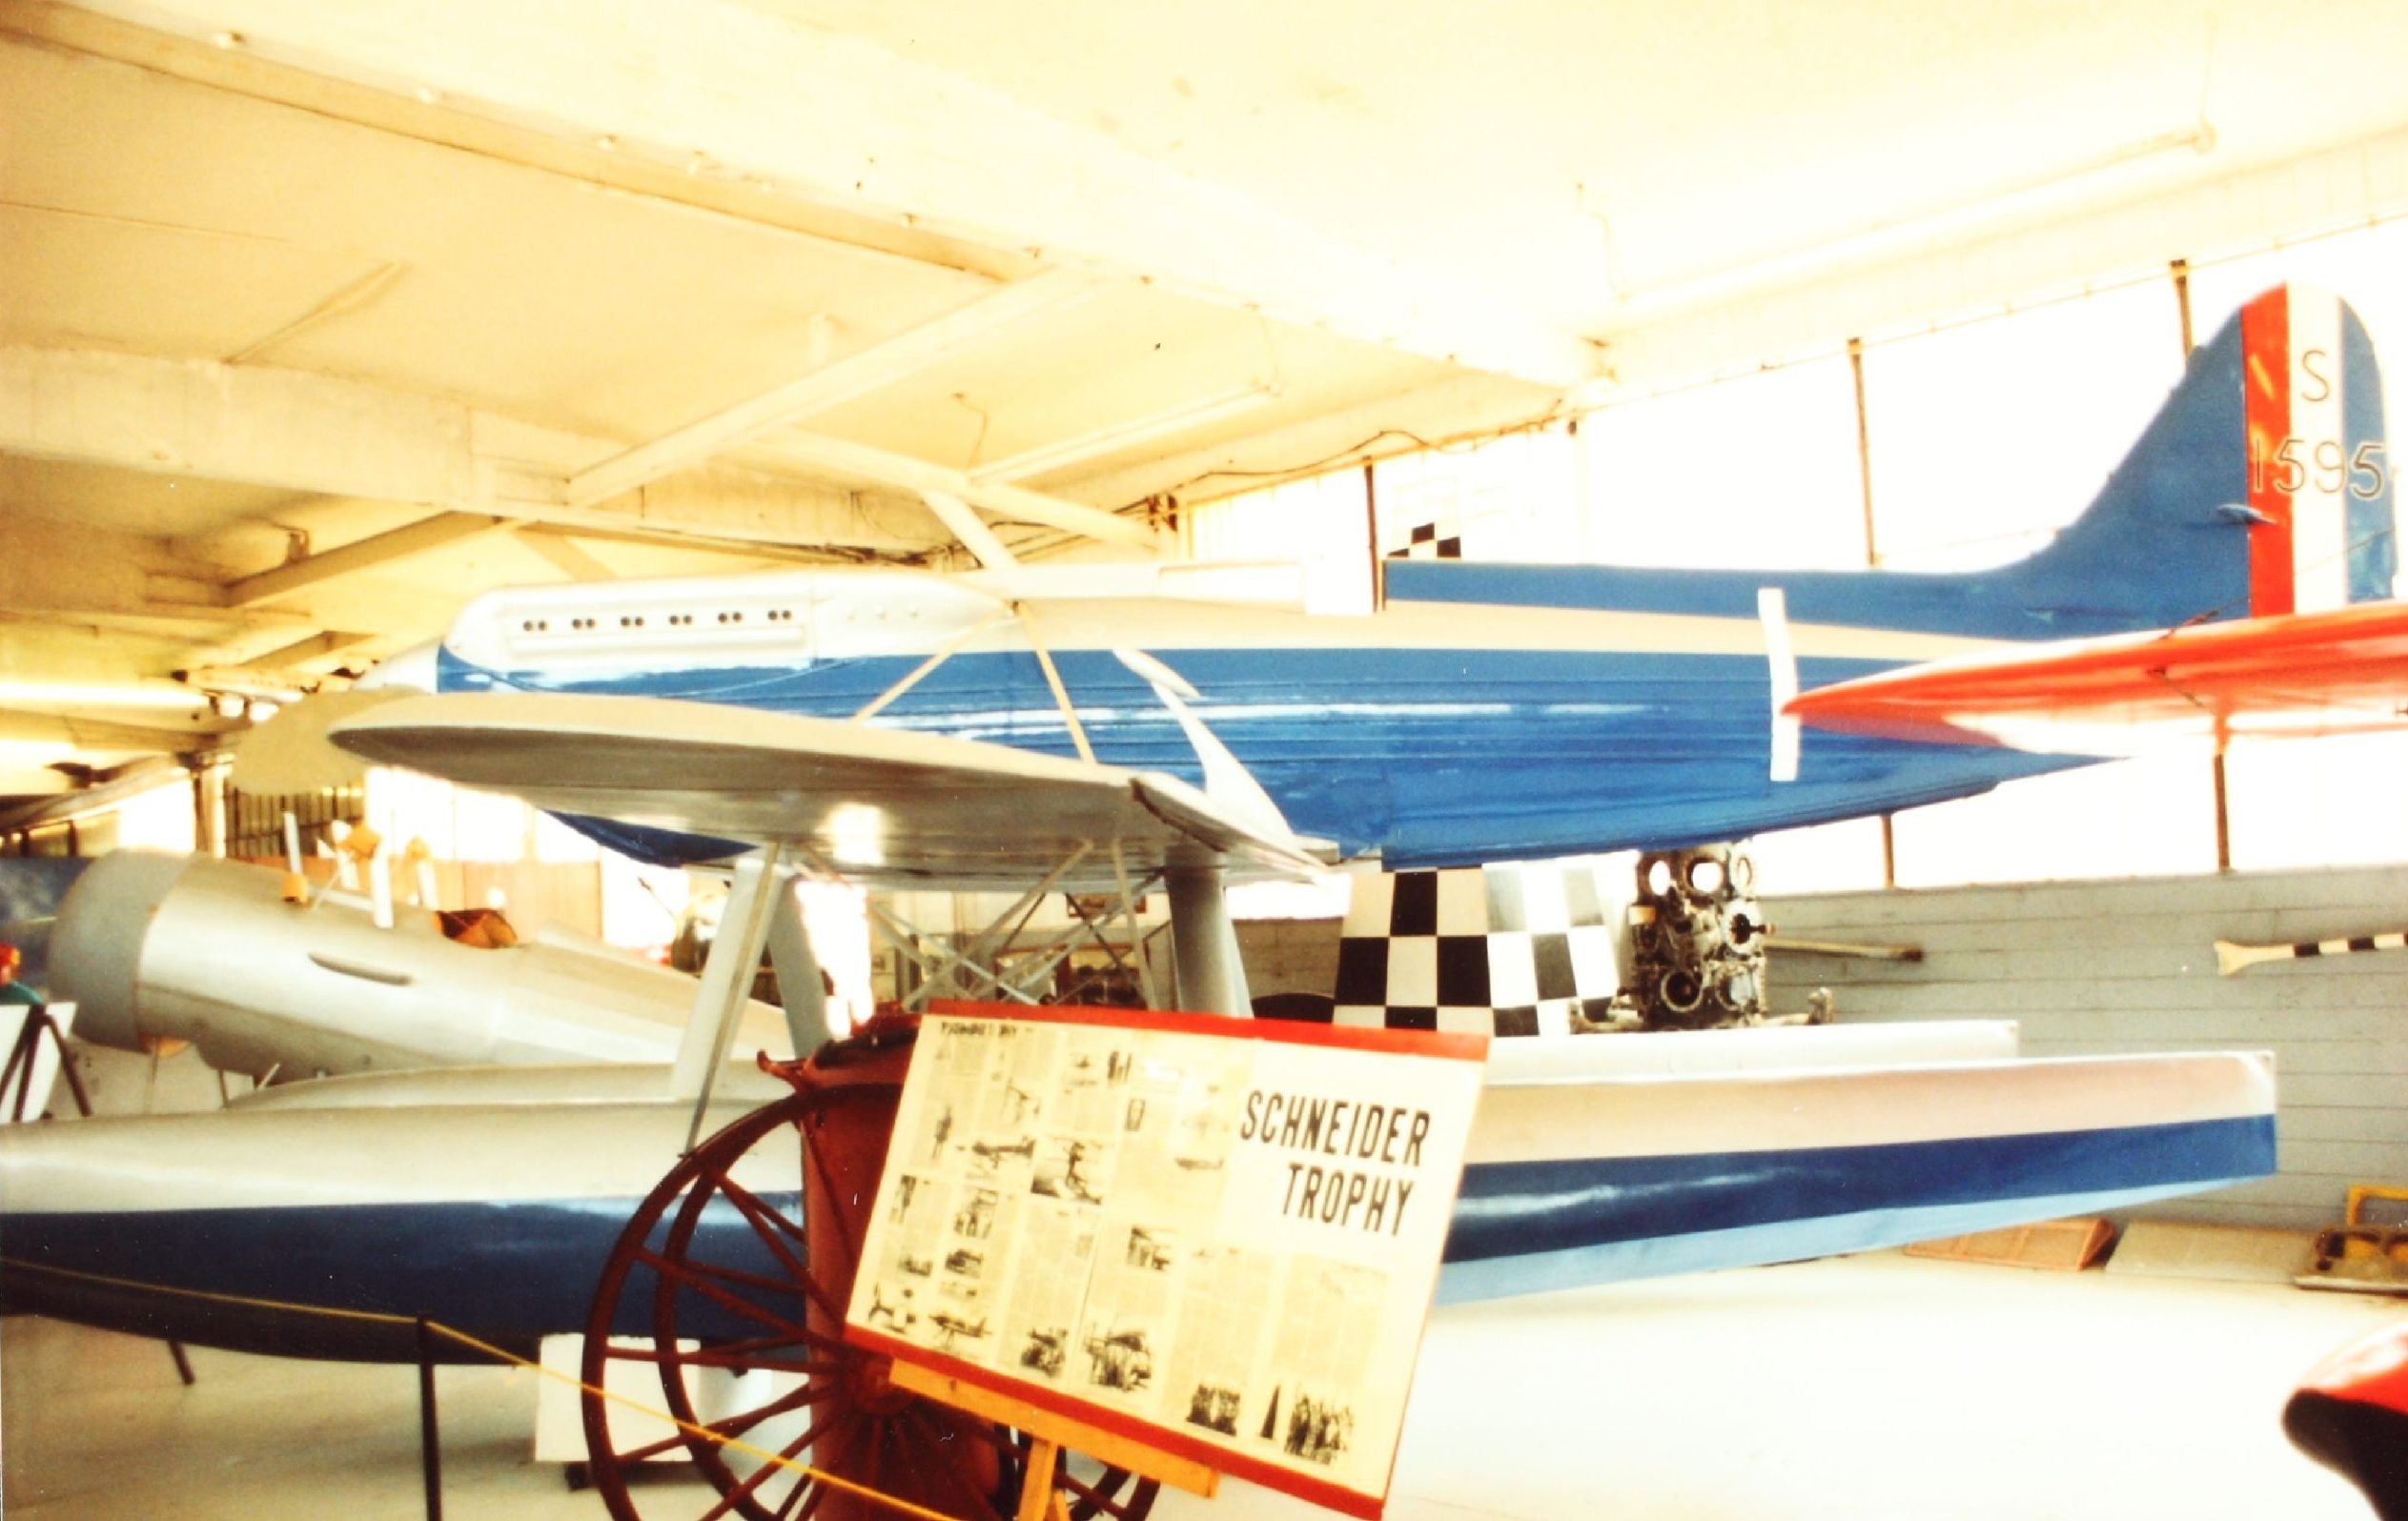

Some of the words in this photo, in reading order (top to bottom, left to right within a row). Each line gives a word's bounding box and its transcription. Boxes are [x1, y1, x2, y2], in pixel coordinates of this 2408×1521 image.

[2301, 348, 2330, 401] S
[2253, 437, 2386, 498] 1595
[1240, 1089, 1431, 1167] SCHNEIDER
[1282, 1162, 1416, 1237] TROPHY
